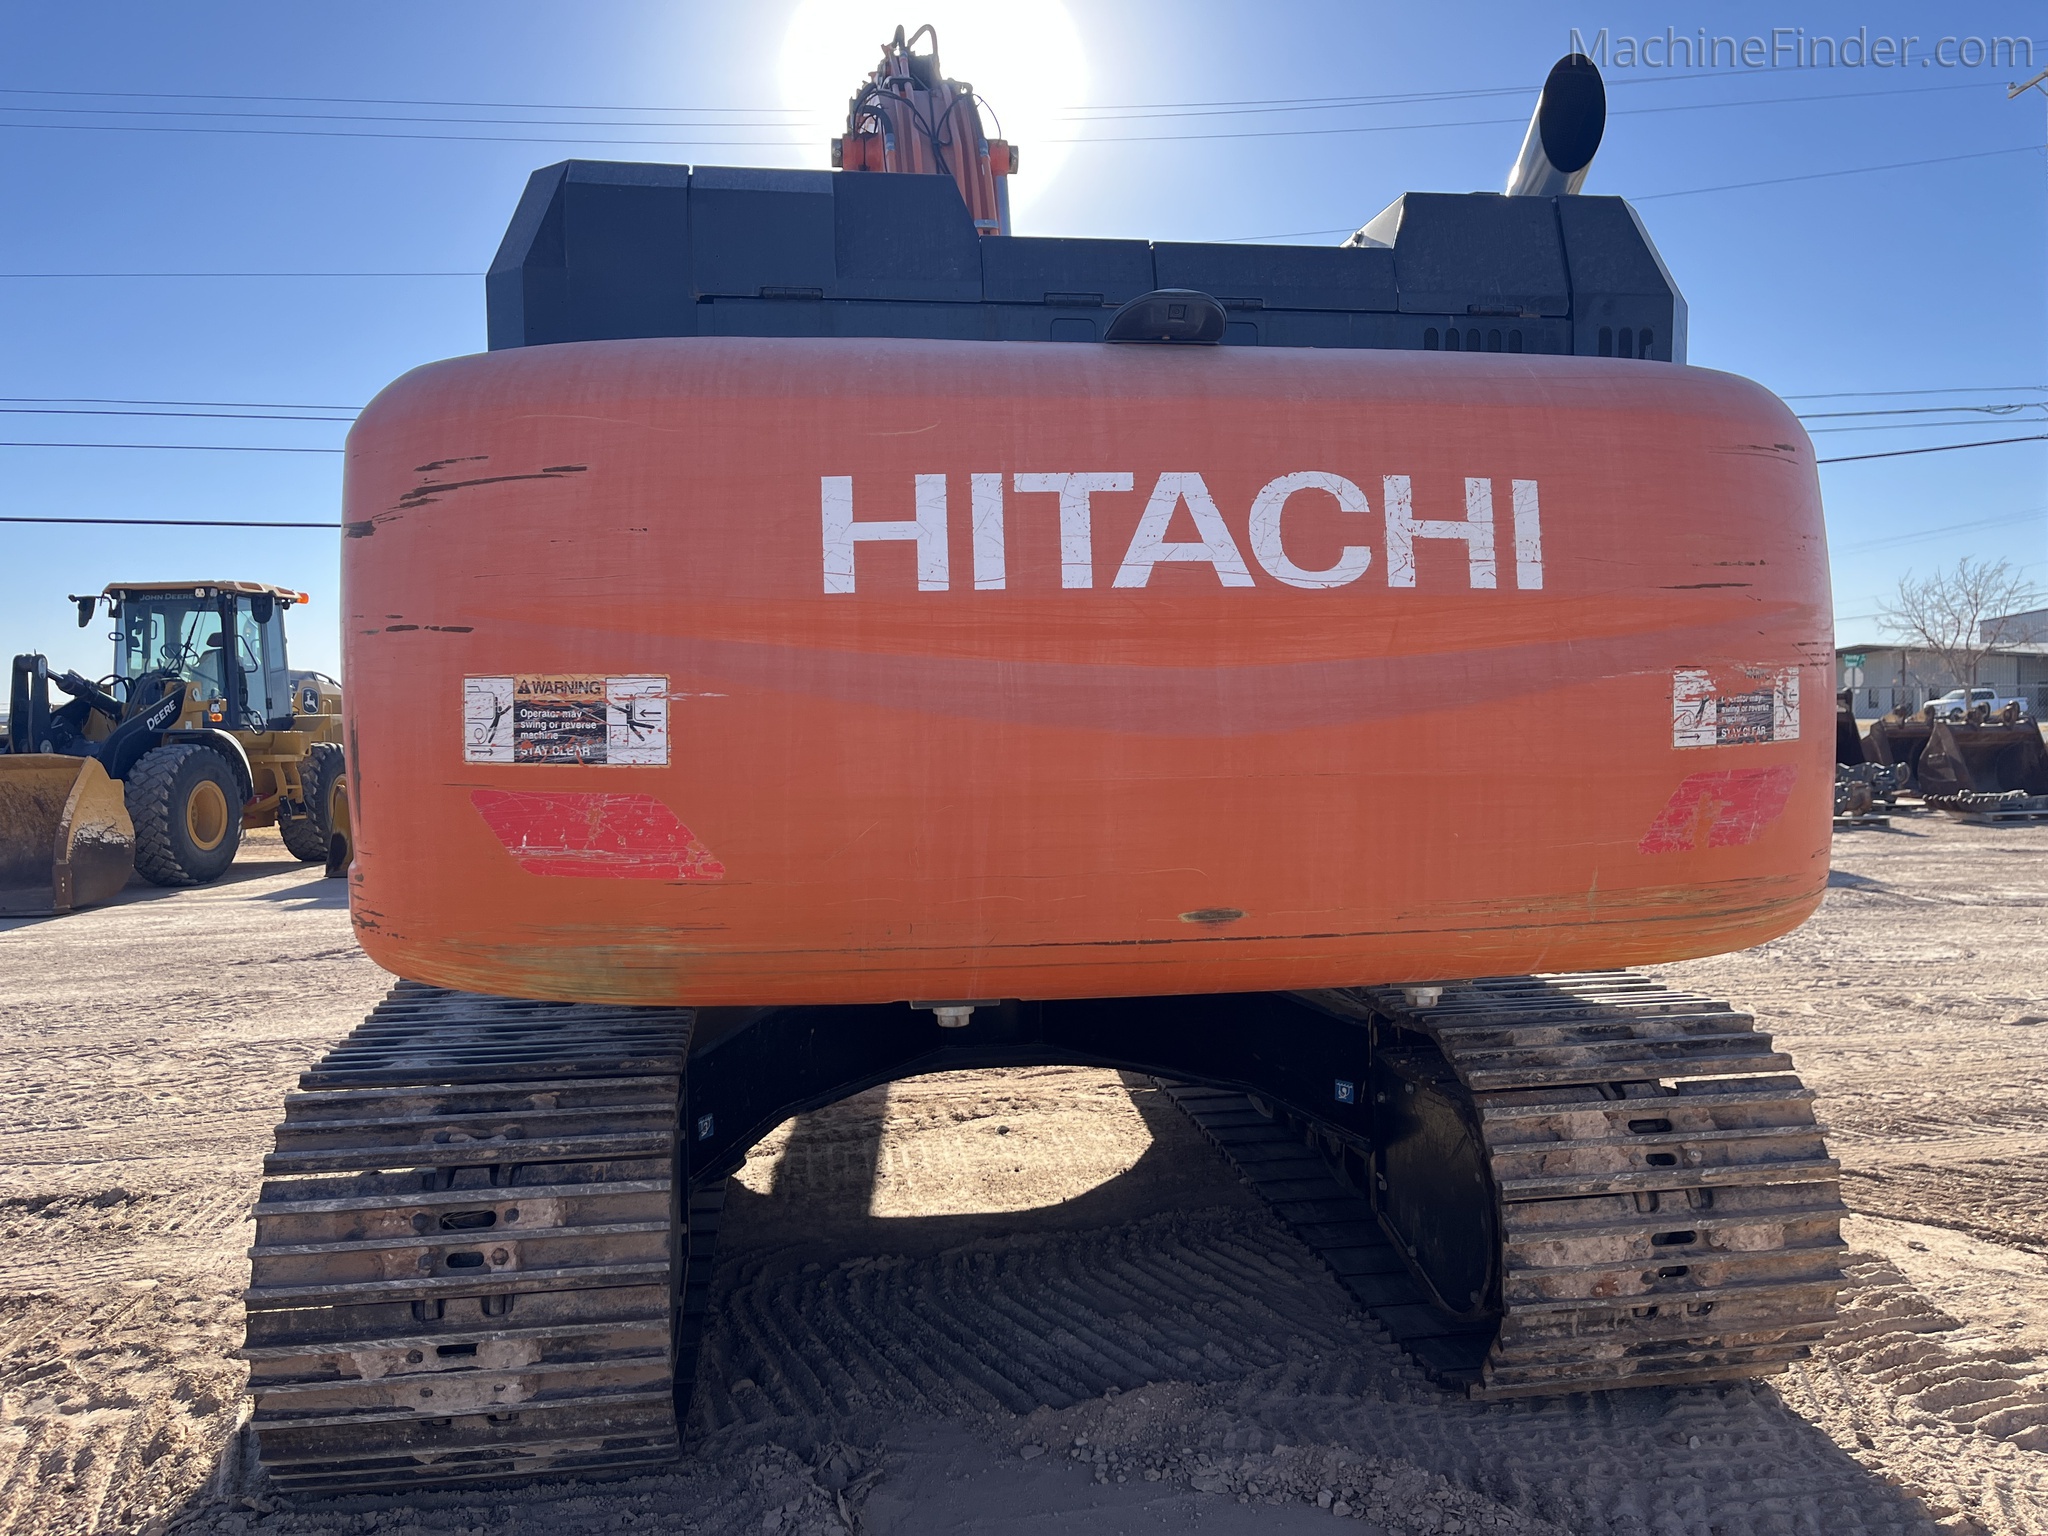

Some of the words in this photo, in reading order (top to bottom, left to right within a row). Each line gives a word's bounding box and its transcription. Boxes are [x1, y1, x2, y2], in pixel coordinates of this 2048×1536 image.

[821, 471, 1544, 594] HITACHI
[532, 681, 601, 694] WARNING
[146, 699, 177, 731] DEERE
[520, 721, 547, 730] swing
[549, 721, 558, 729] or
[561, 720, 597, 729] reverse
[520, 731, 559, 740] machine
[552, 745, 591, 756] CLEAR
